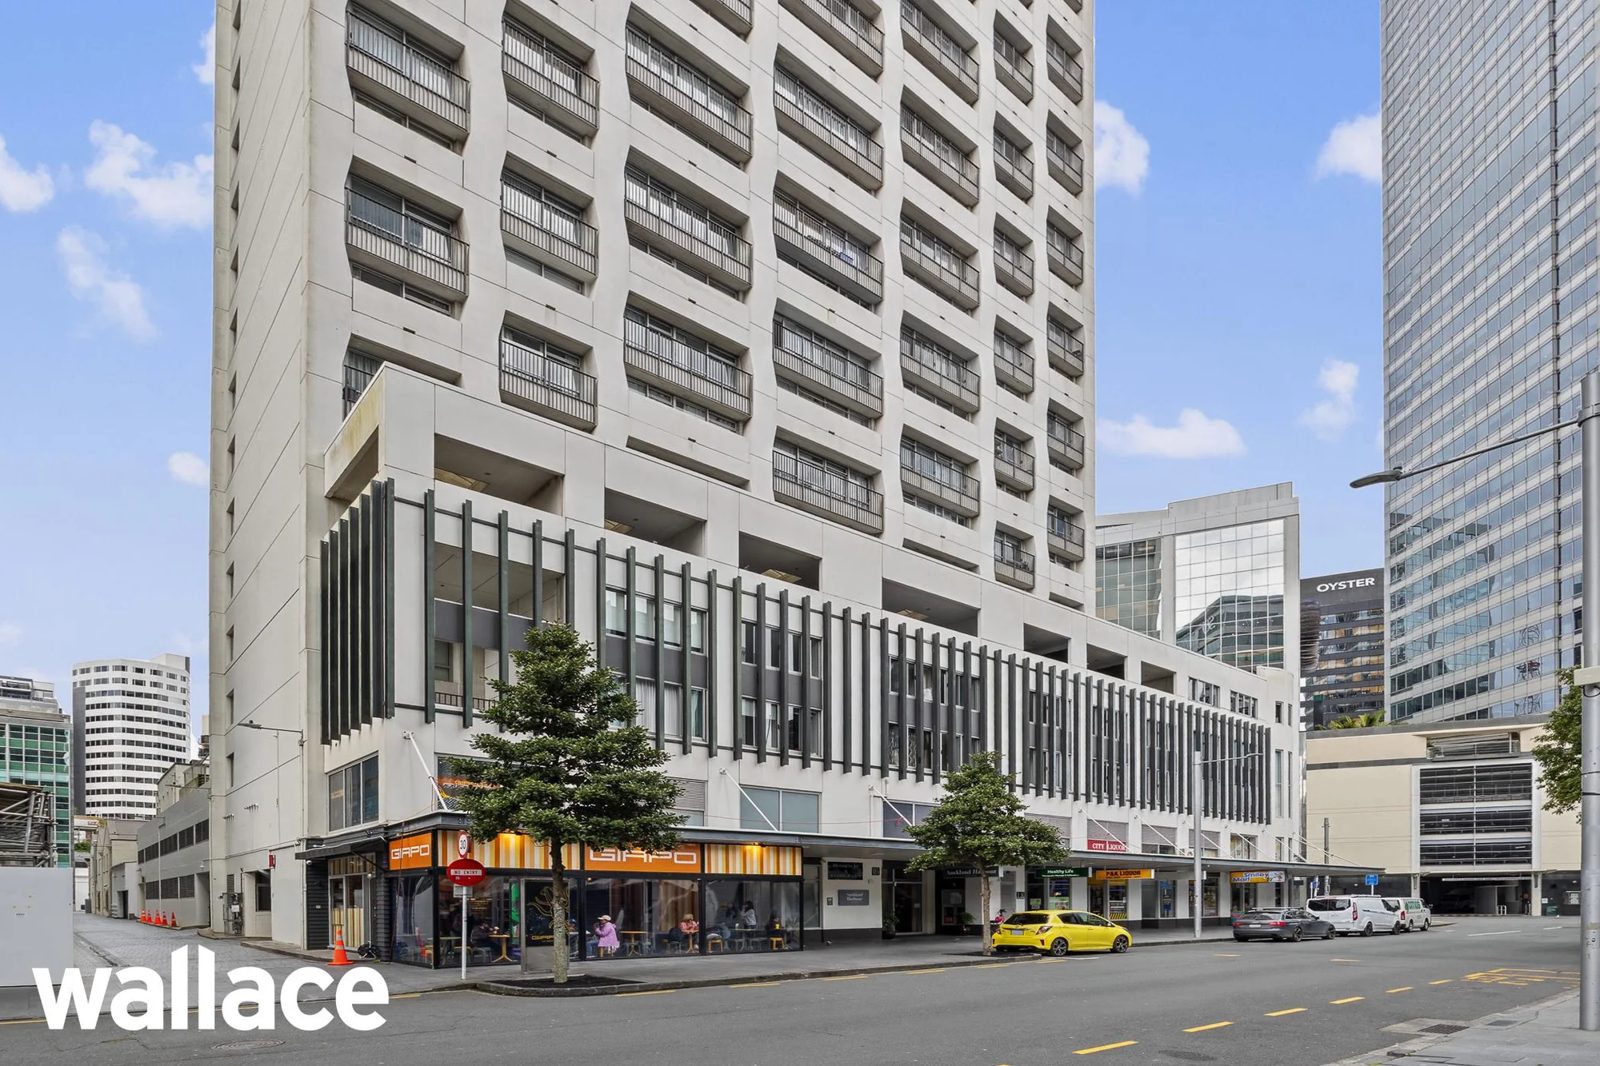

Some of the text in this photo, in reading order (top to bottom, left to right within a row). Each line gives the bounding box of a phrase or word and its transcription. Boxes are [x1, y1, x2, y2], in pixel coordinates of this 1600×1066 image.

[1316, 577, 1375, 592] OYSTER
[391, 844, 430, 860] GIAPO
[460, 839, 466, 850] 30
[1092, 842, 1105, 850] CITY
[589, 847, 697, 865] GIAPO
